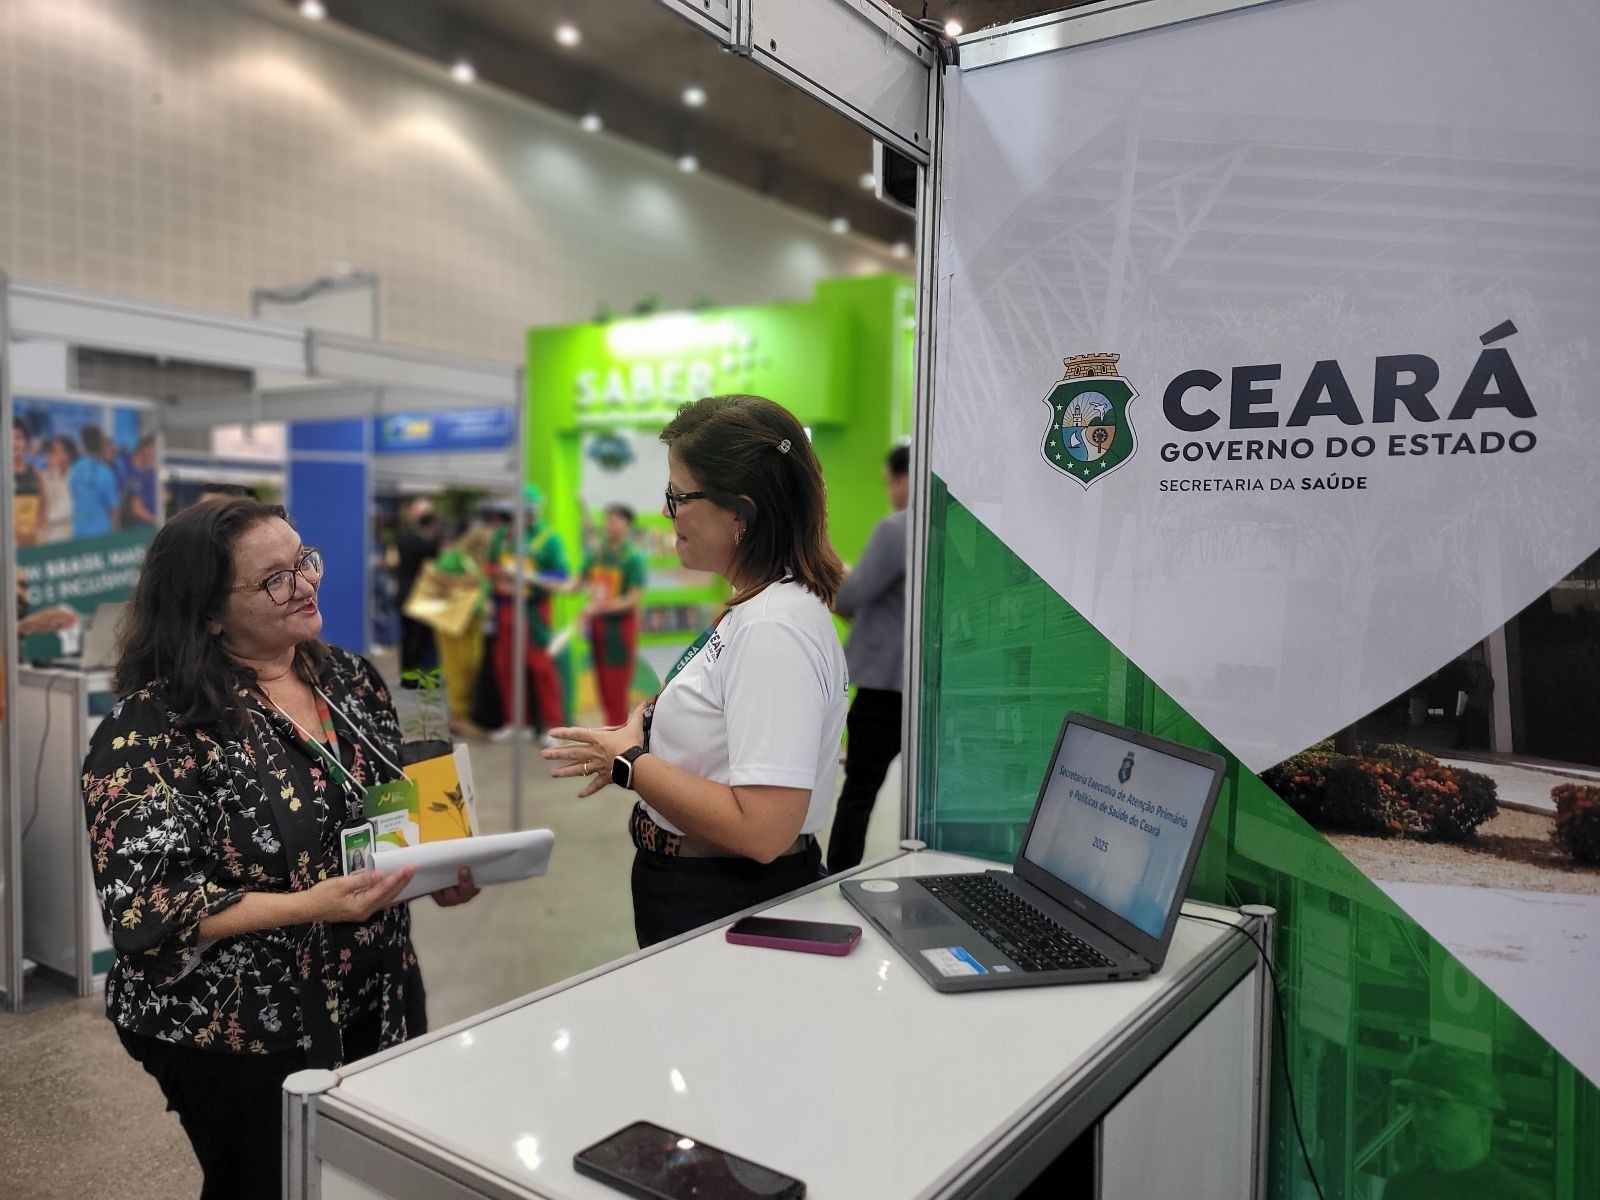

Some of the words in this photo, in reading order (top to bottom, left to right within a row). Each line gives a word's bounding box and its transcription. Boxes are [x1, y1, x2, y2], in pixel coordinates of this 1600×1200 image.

[575, 361, 715, 408] SABER
[1162, 319, 1538, 432] CEARÁ
[1160, 438, 1315, 463] GOVERNO
[1326, 435, 1376, 458] DO
[1388, 430, 1537, 456] ESTADO
[1159, 478, 1264, 492] SECRETARIA
[1270, 478, 1296, 491] DA
[1300, 472, 1368, 490] SAÚDE
[676, 644, 699, 670] CEARÁ
[1059, 765, 1088, 785] Secretaria
[1087, 777, 1116, 798] Executiva
[1117, 789, 1126, 801] de
[1127, 793, 1155, 814] Atenção
[1155, 805, 1188, 828] Primária
[1074, 790, 1099, 809] Políticas
[1099, 801, 1108, 813] de
[1109, 804, 1129, 823] Saúde
[1129, 815, 1139, 828] do
[1139, 819, 1161, 837] Ceará
[1092, 836, 1109, 852] 2025
